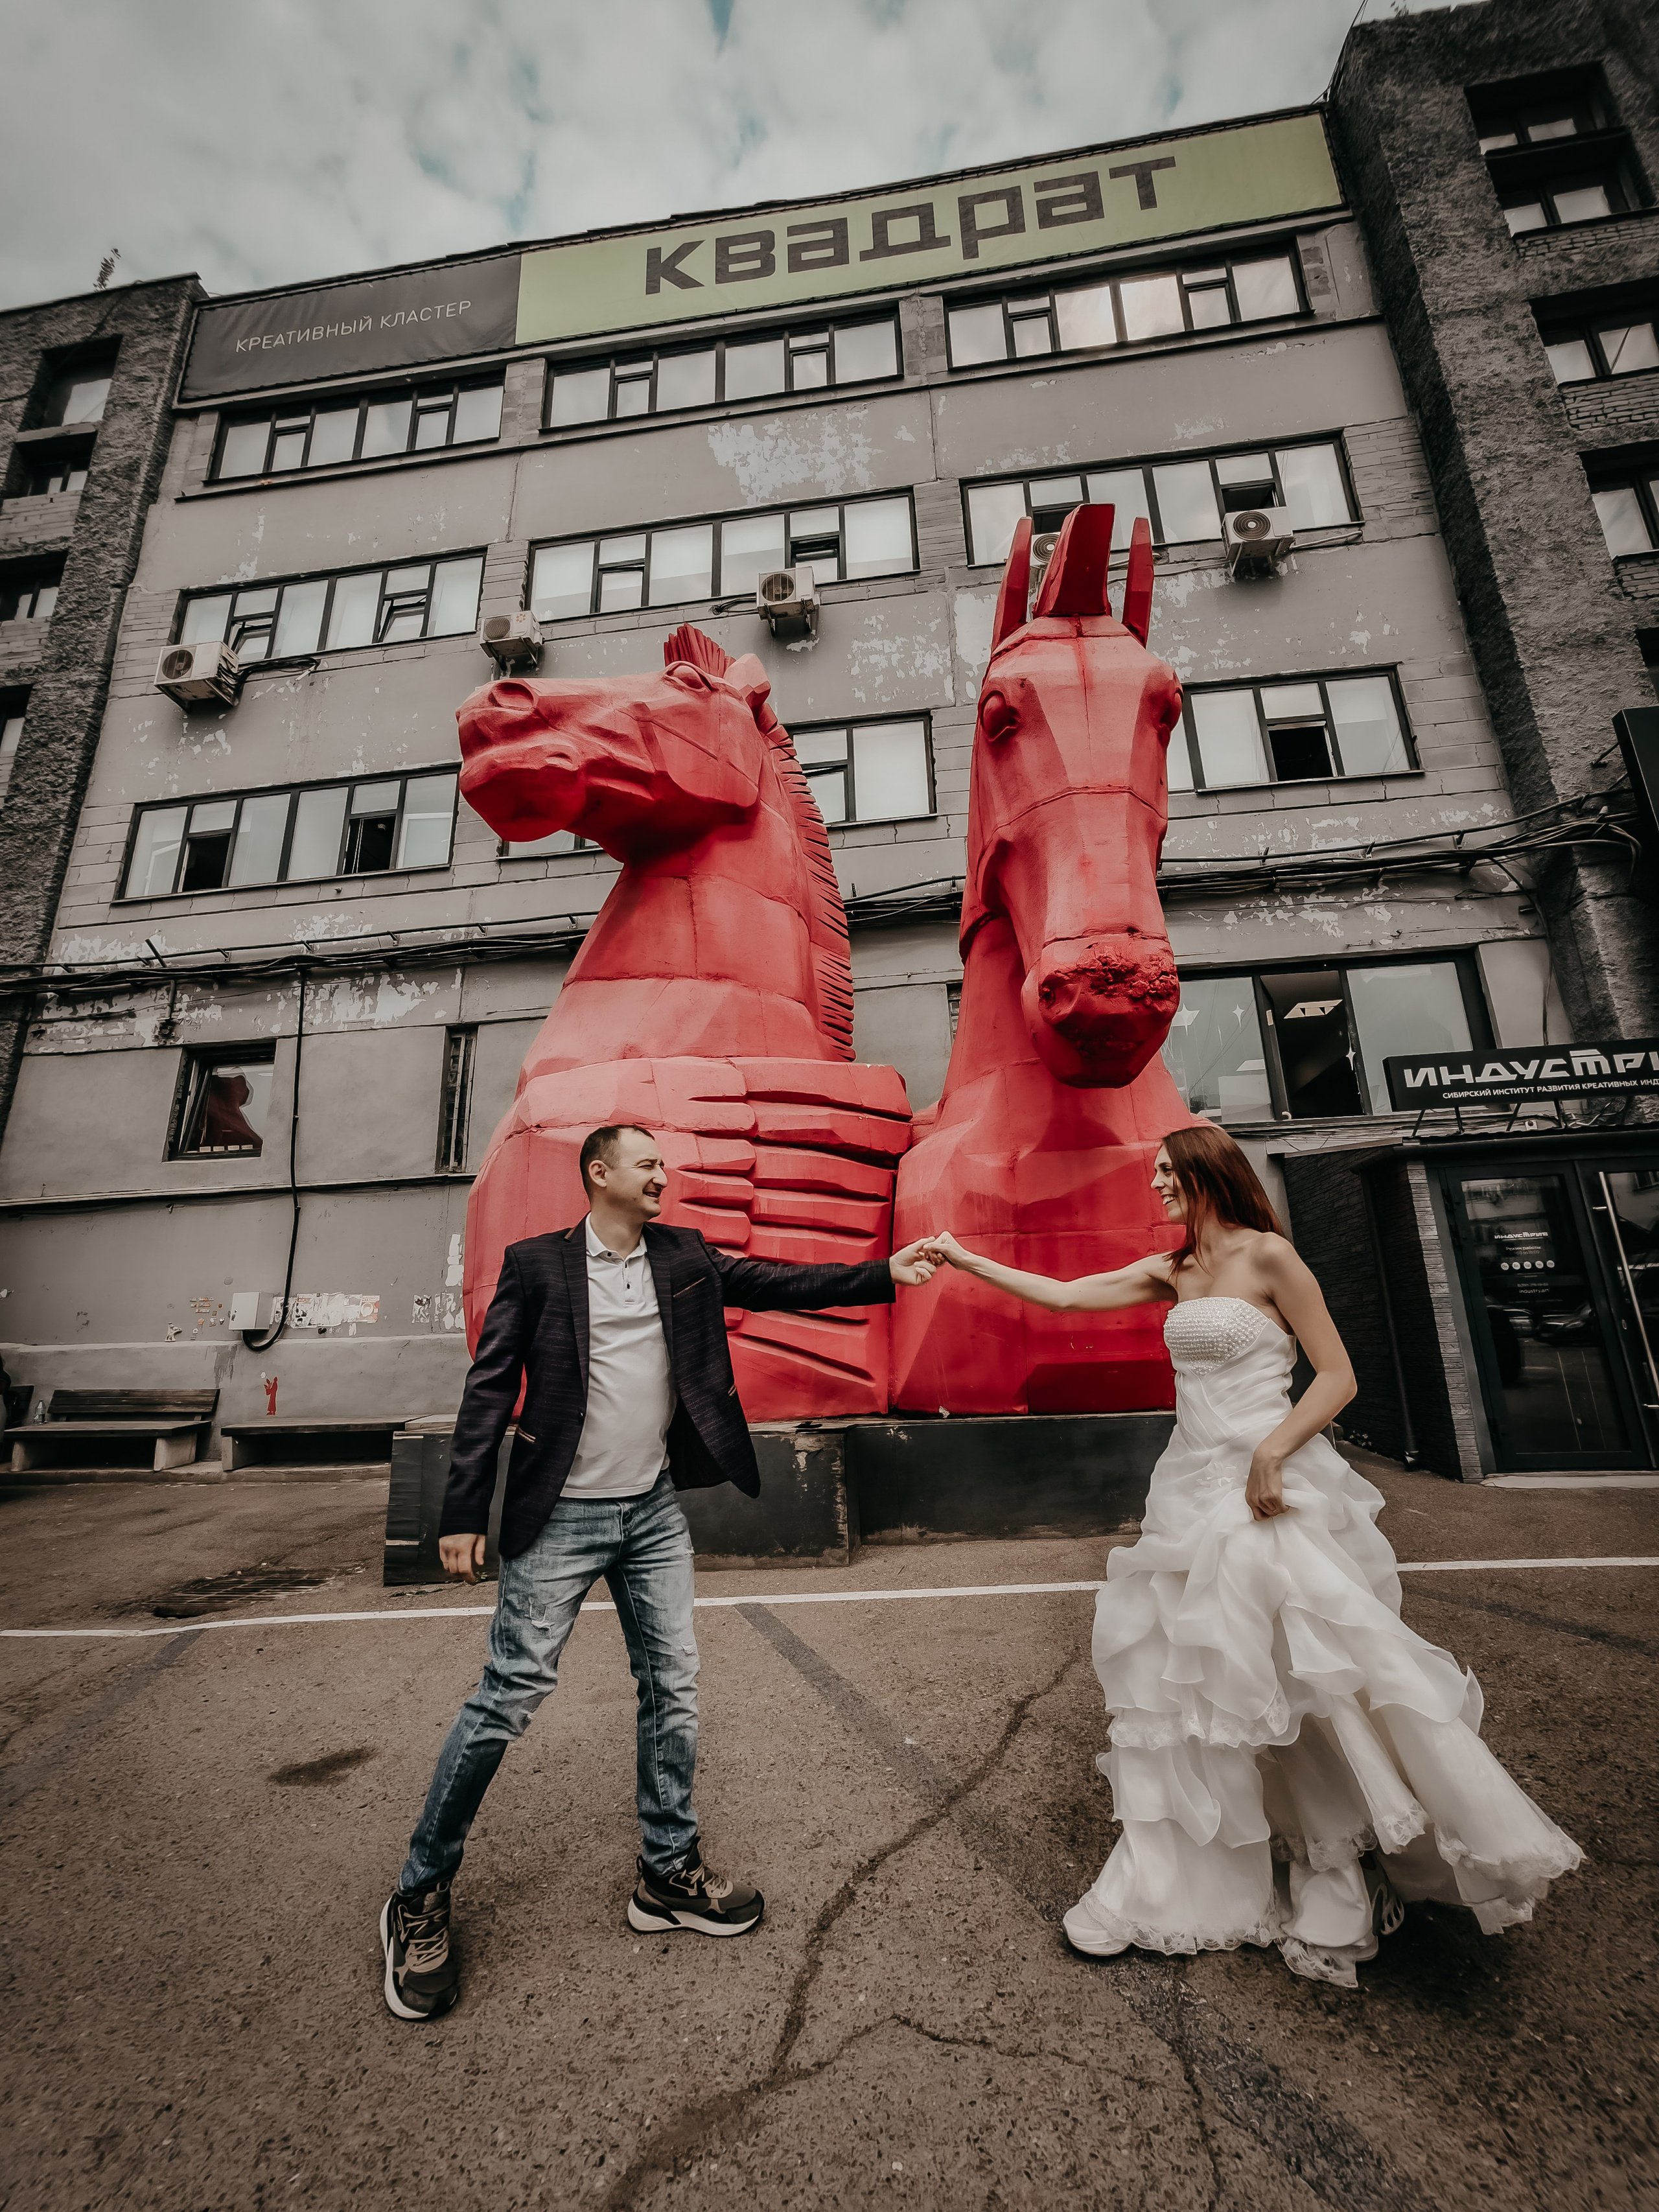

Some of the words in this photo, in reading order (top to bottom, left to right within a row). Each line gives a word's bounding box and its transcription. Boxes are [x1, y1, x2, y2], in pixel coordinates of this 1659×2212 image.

[235, 315, 373, 353] КРЕАТИВНЫЙ
[380, 300, 472, 329] КЛАСТЕР
[1443, 1088, 1491, 1099] СИБИРСКИЙ
[1492, 1086, 1535, 1096] ИНСТИТУТ
[1537, 1083, 1581, 1093] РАЗВИТИЯ
[1582, 1080, 1638, 1089] КРЕАТИВНЫХ
